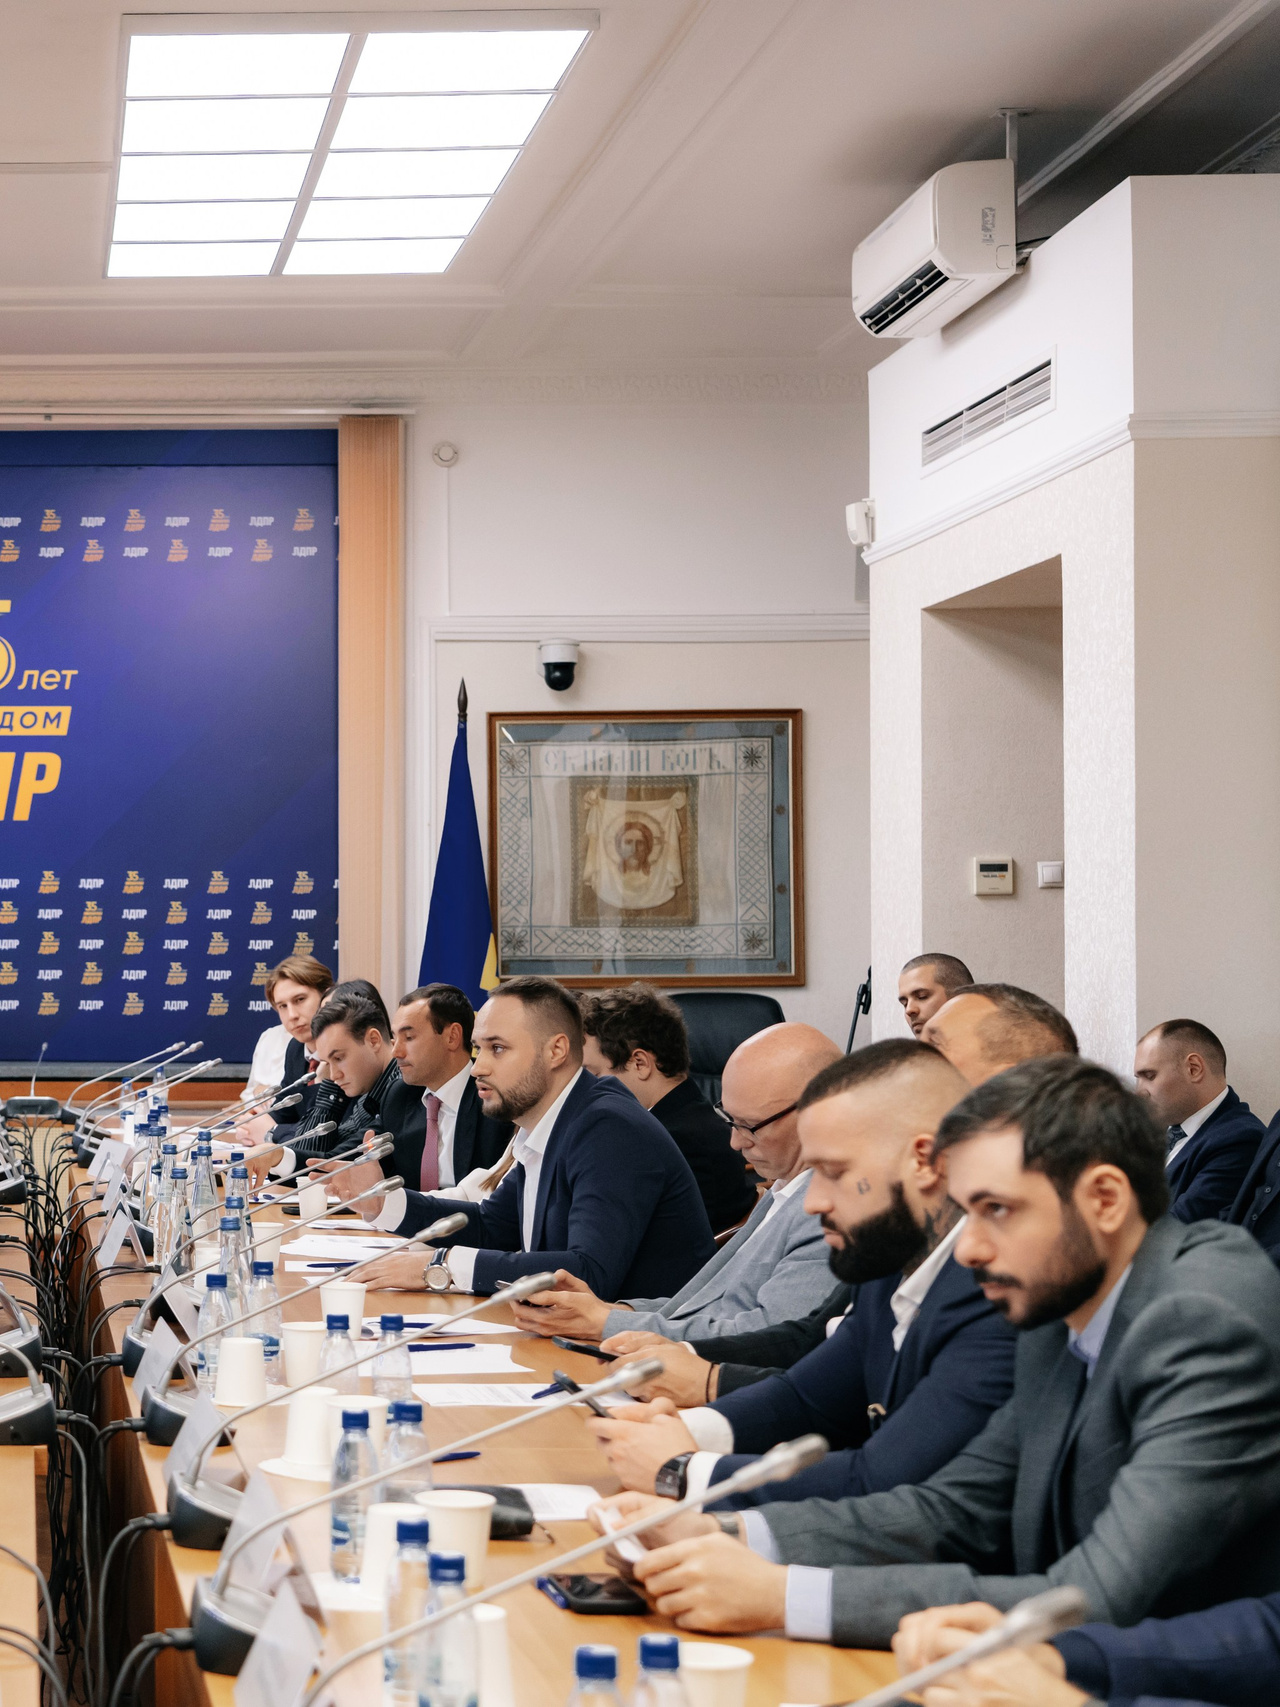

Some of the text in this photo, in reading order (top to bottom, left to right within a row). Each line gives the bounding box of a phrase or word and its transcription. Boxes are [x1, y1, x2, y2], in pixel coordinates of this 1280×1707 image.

[17, 669, 79, 690] лет
[42, 871, 54, 881] 35
[127, 871, 139, 881] 35
[211, 871, 223, 881] 35
[296, 871, 308, 881] 35
[78, 878, 104, 890] ЛДПР
[163, 879, 189, 890] ЛДПР
[248, 879, 273, 890] ЛДПР
[1, 901, 13, 911] 35
[85, 901, 97, 911] 35
[170, 901, 182, 911] 35
[254, 902, 266, 912] 35
[37, 909, 63, 920] ЛДПР
[122, 909, 147, 920] ЛДПР
[206, 909, 232, 920] ЛДПР
[291, 909, 317, 920] ЛДПР
[42, 932, 54, 942] 35
[127, 932, 139, 942] 35
[211, 932, 223, 942] 35
[297, 932, 309, 942] 35
[78, 939, 104, 950] ЛДПР
[163, 940, 188, 951] ЛДПР
[248, 940, 273, 951] ЛДПР
[1, 962, 13, 972] 35
[85, 962, 97, 972] 35
[169, 963, 181, 973] 35
[253, 963, 265, 973] 35
[37, 970, 62, 981] ЛДПР
[121, 970, 147, 981] ЛДПР
[206, 970, 232, 981] ЛДПР
[42, 992, 54, 1002] 35
[127, 992, 139, 1002] 35
[211, 993, 223, 1003] 35
[78, 1000, 104, 1011] ЛДПР
[163, 1000, 188, 1011] ЛДПР
